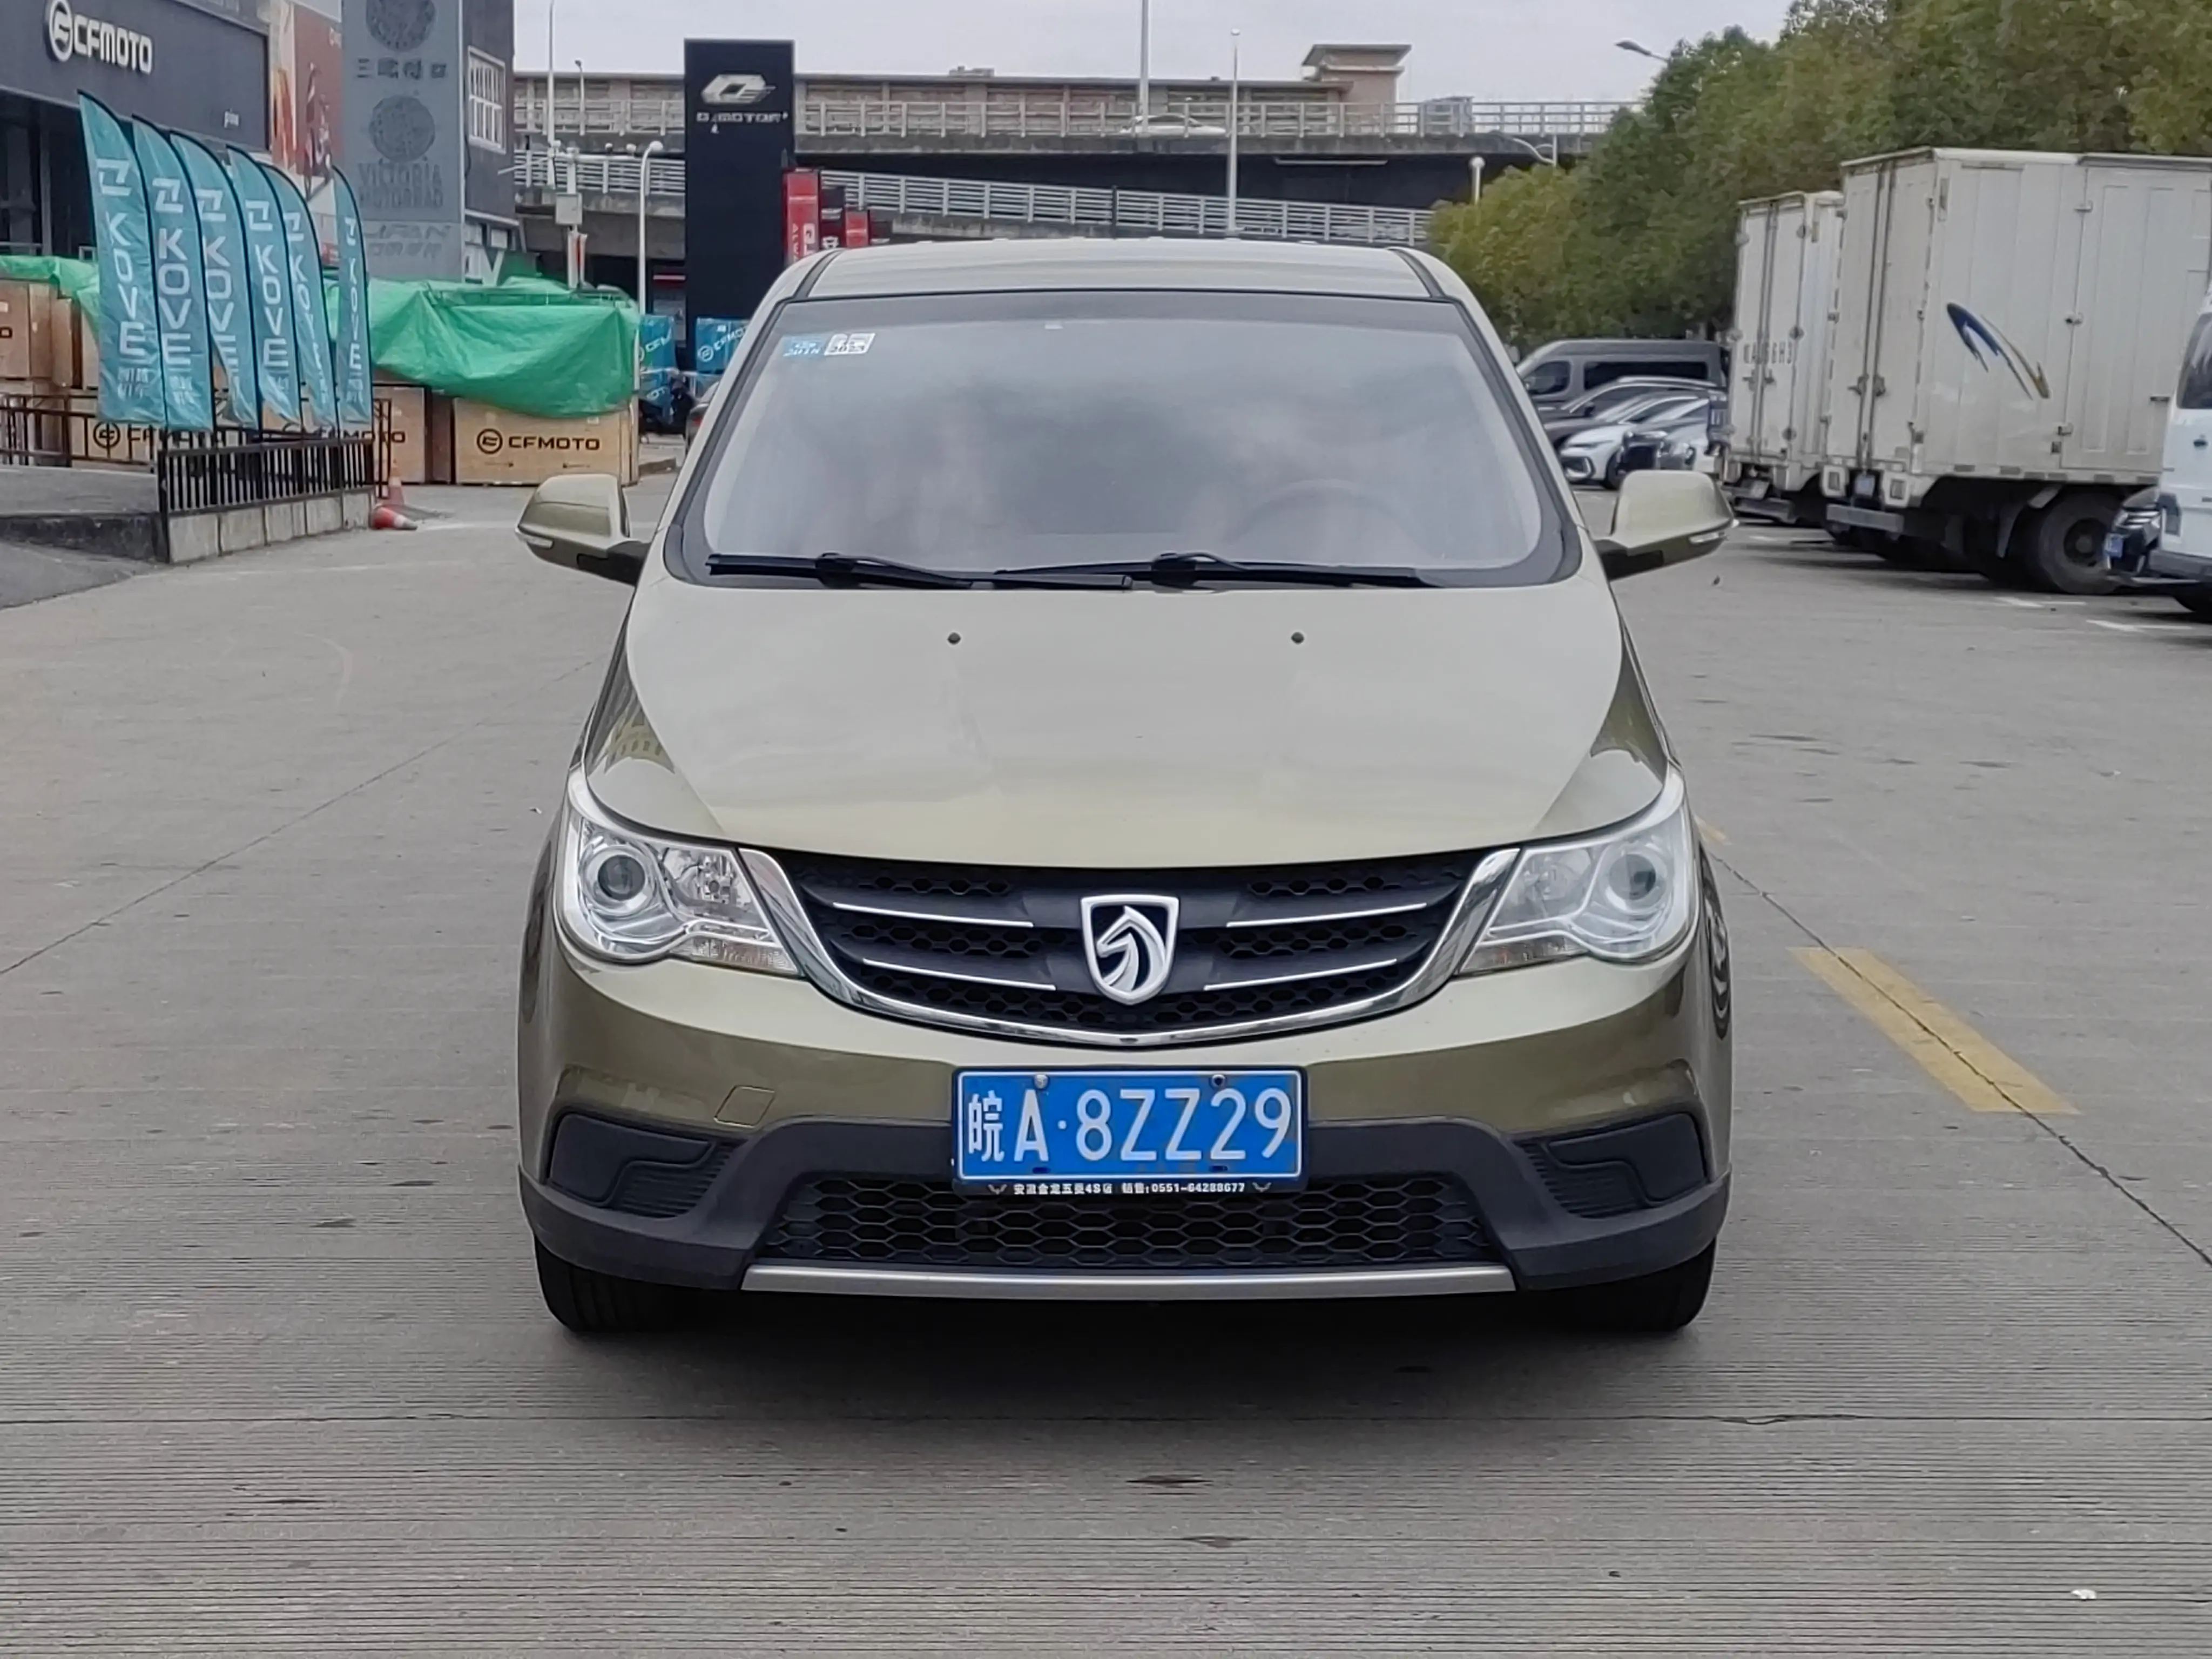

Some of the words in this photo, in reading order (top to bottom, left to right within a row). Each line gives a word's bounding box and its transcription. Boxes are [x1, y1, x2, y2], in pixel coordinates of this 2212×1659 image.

[75, 14, 152, 75] CFMOTO
[105, 211, 145, 356] KOVE
[158, 227, 192, 365] KOVE
[203, 235, 239, 366] KOVE
[255, 244, 289, 367] KOVE
[349, 258, 362, 370] KOVE
[508, 436, 600, 450] CFMOTO
[968, 1088, 1291, 1161] 皖A·8ZZ29
